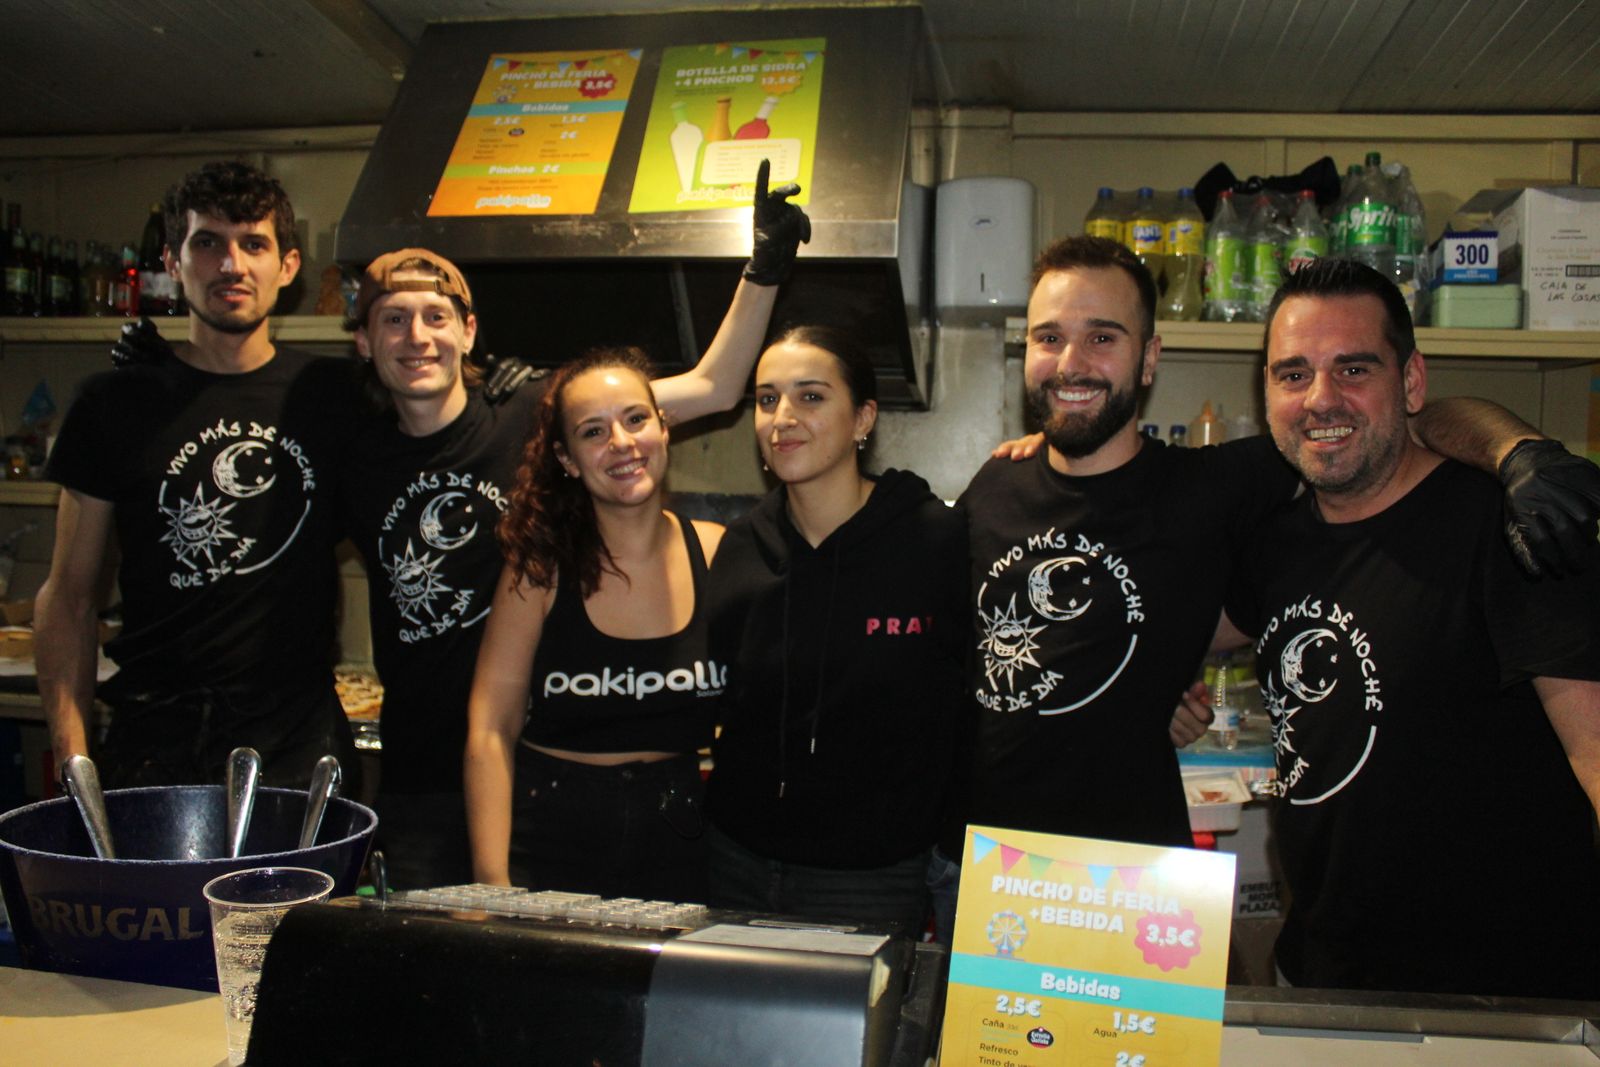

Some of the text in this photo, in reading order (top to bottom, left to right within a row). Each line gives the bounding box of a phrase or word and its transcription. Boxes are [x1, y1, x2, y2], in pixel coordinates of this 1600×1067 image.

[501, 71, 546, 81] PINCHO
[569, 69, 609, 79] FERIA
[676, 62, 806, 78] BOTELLA DE SIDRA
[682, 78, 691, 87] 4
[694, 74, 755, 87] PINCHOS
[534, 80, 581, 90] BEBIDA
[522, 103, 570, 113] Bebidas
[488, 164, 536, 175] Pinchos
[1455, 244, 1490, 266] 300
[248, 421, 277, 442] DE
[279, 436, 316, 492] NOCHE
[446, 472, 473, 489] DE
[477, 480, 510, 515] NOC
[169, 572, 204, 590] QUE
[206, 559, 232, 583] DE
[1074, 533, 1105, 558] DE
[1102, 554, 1145, 624] NOCHE
[398, 625, 432, 644] QUE
[431, 613, 457, 636] DE
[1327, 603, 1354, 631] DE
[1349, 628, 1384, 711] NOCHE
[975, 688, 1003, 712] QUE
[1004, 691, 1033, 713] DE
[990, 874, 1182, 917] PINCHO DE FERIA
[31, 899, 205, 942] BRUGAL
[1145, 923, 1197, 948] 3,5€
[1040, 971, 1121, 1001] Bebidas
[996, 993, 1043, 1018] 2,5€
[981, 1018, 1005, 1029] Caña
[1093, 1027, 1118, 1039] Agua
[1113, 1010, 1156, 1036] 1,5€
[978, 1055, 1001, 1067] Tinto
[979, 1042, 1020, 1057] Refresco
[1115, 1051, 1146, 1067] 2€
